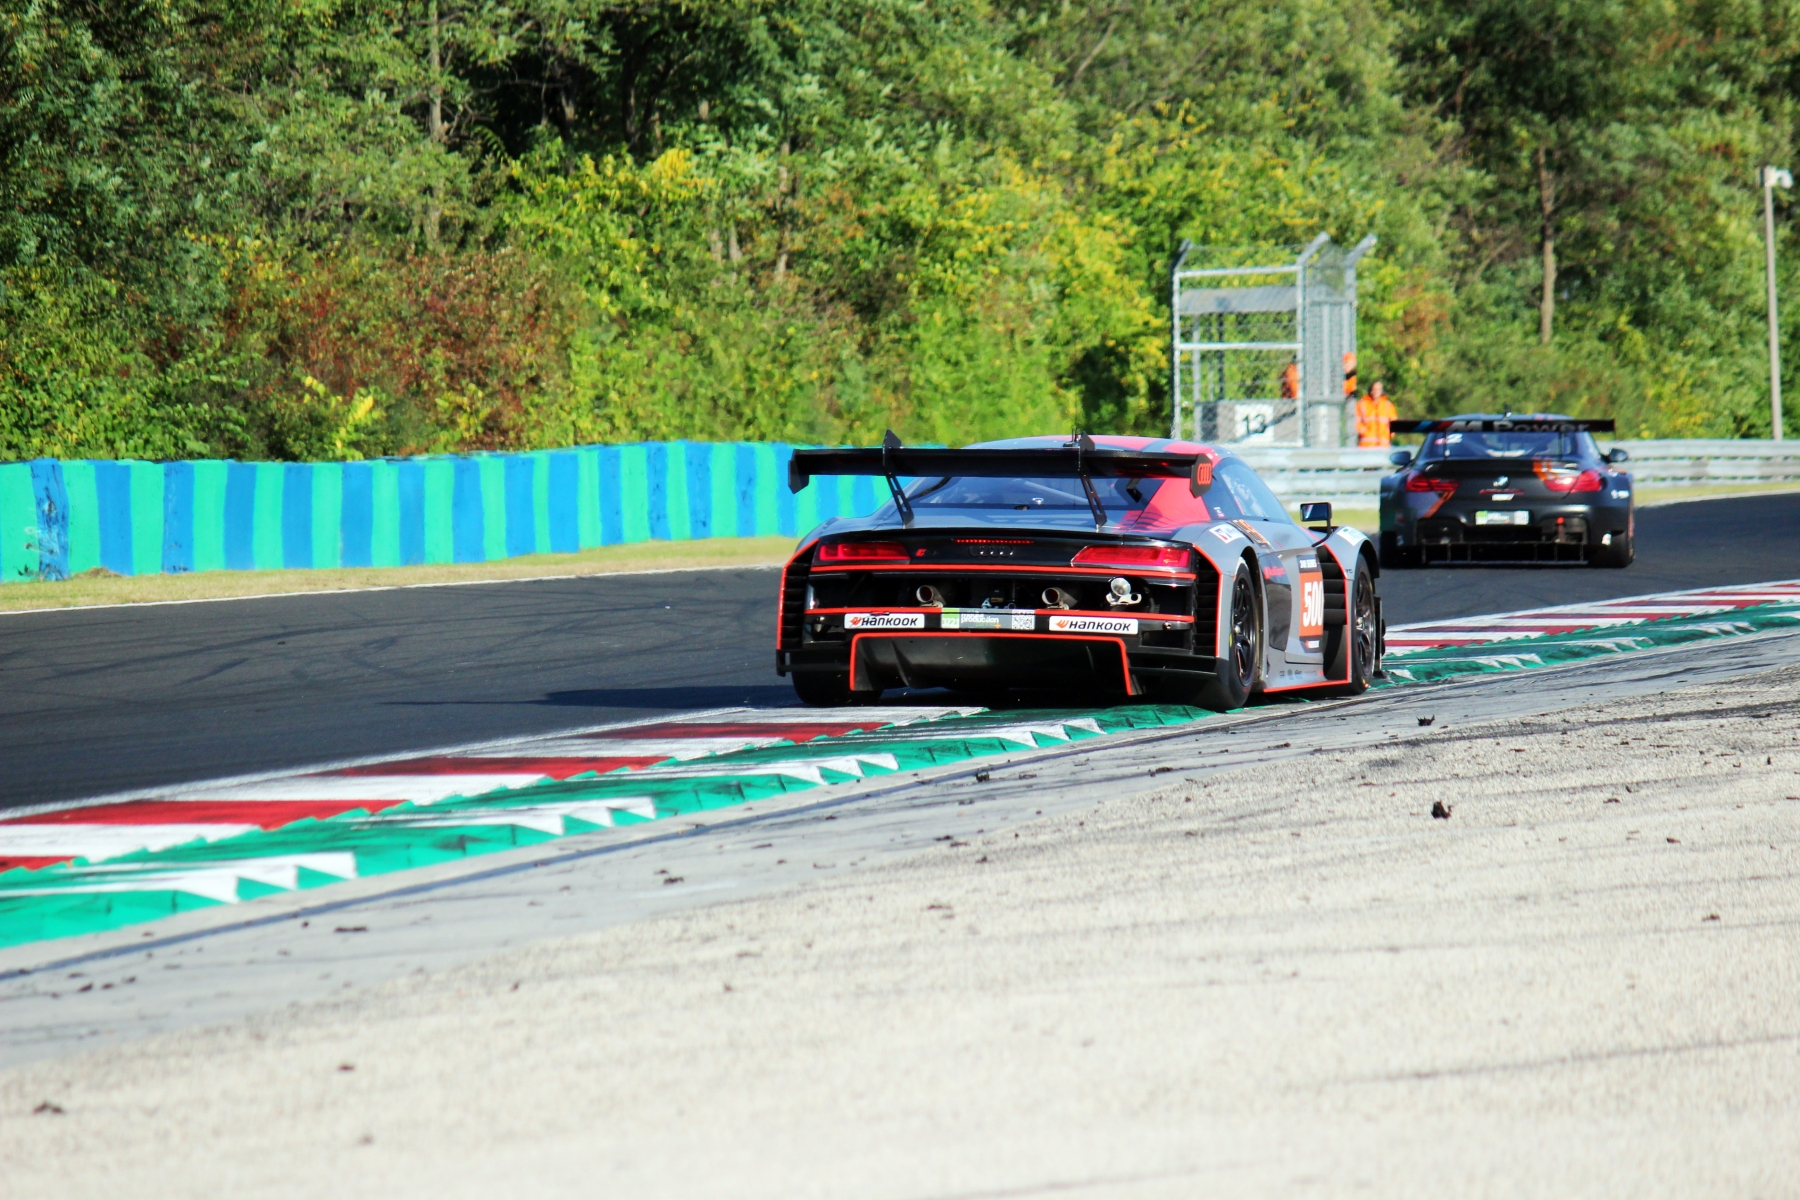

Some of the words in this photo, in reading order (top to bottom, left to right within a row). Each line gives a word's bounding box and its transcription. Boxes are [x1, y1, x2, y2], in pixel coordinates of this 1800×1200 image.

[1242, 413, 1266, 434] 13
[1492, 420, 1590, 432] Power
[861, 616, 919, 627] HANKOOK
[1068, 620, 1132, 632] HANKOOK
